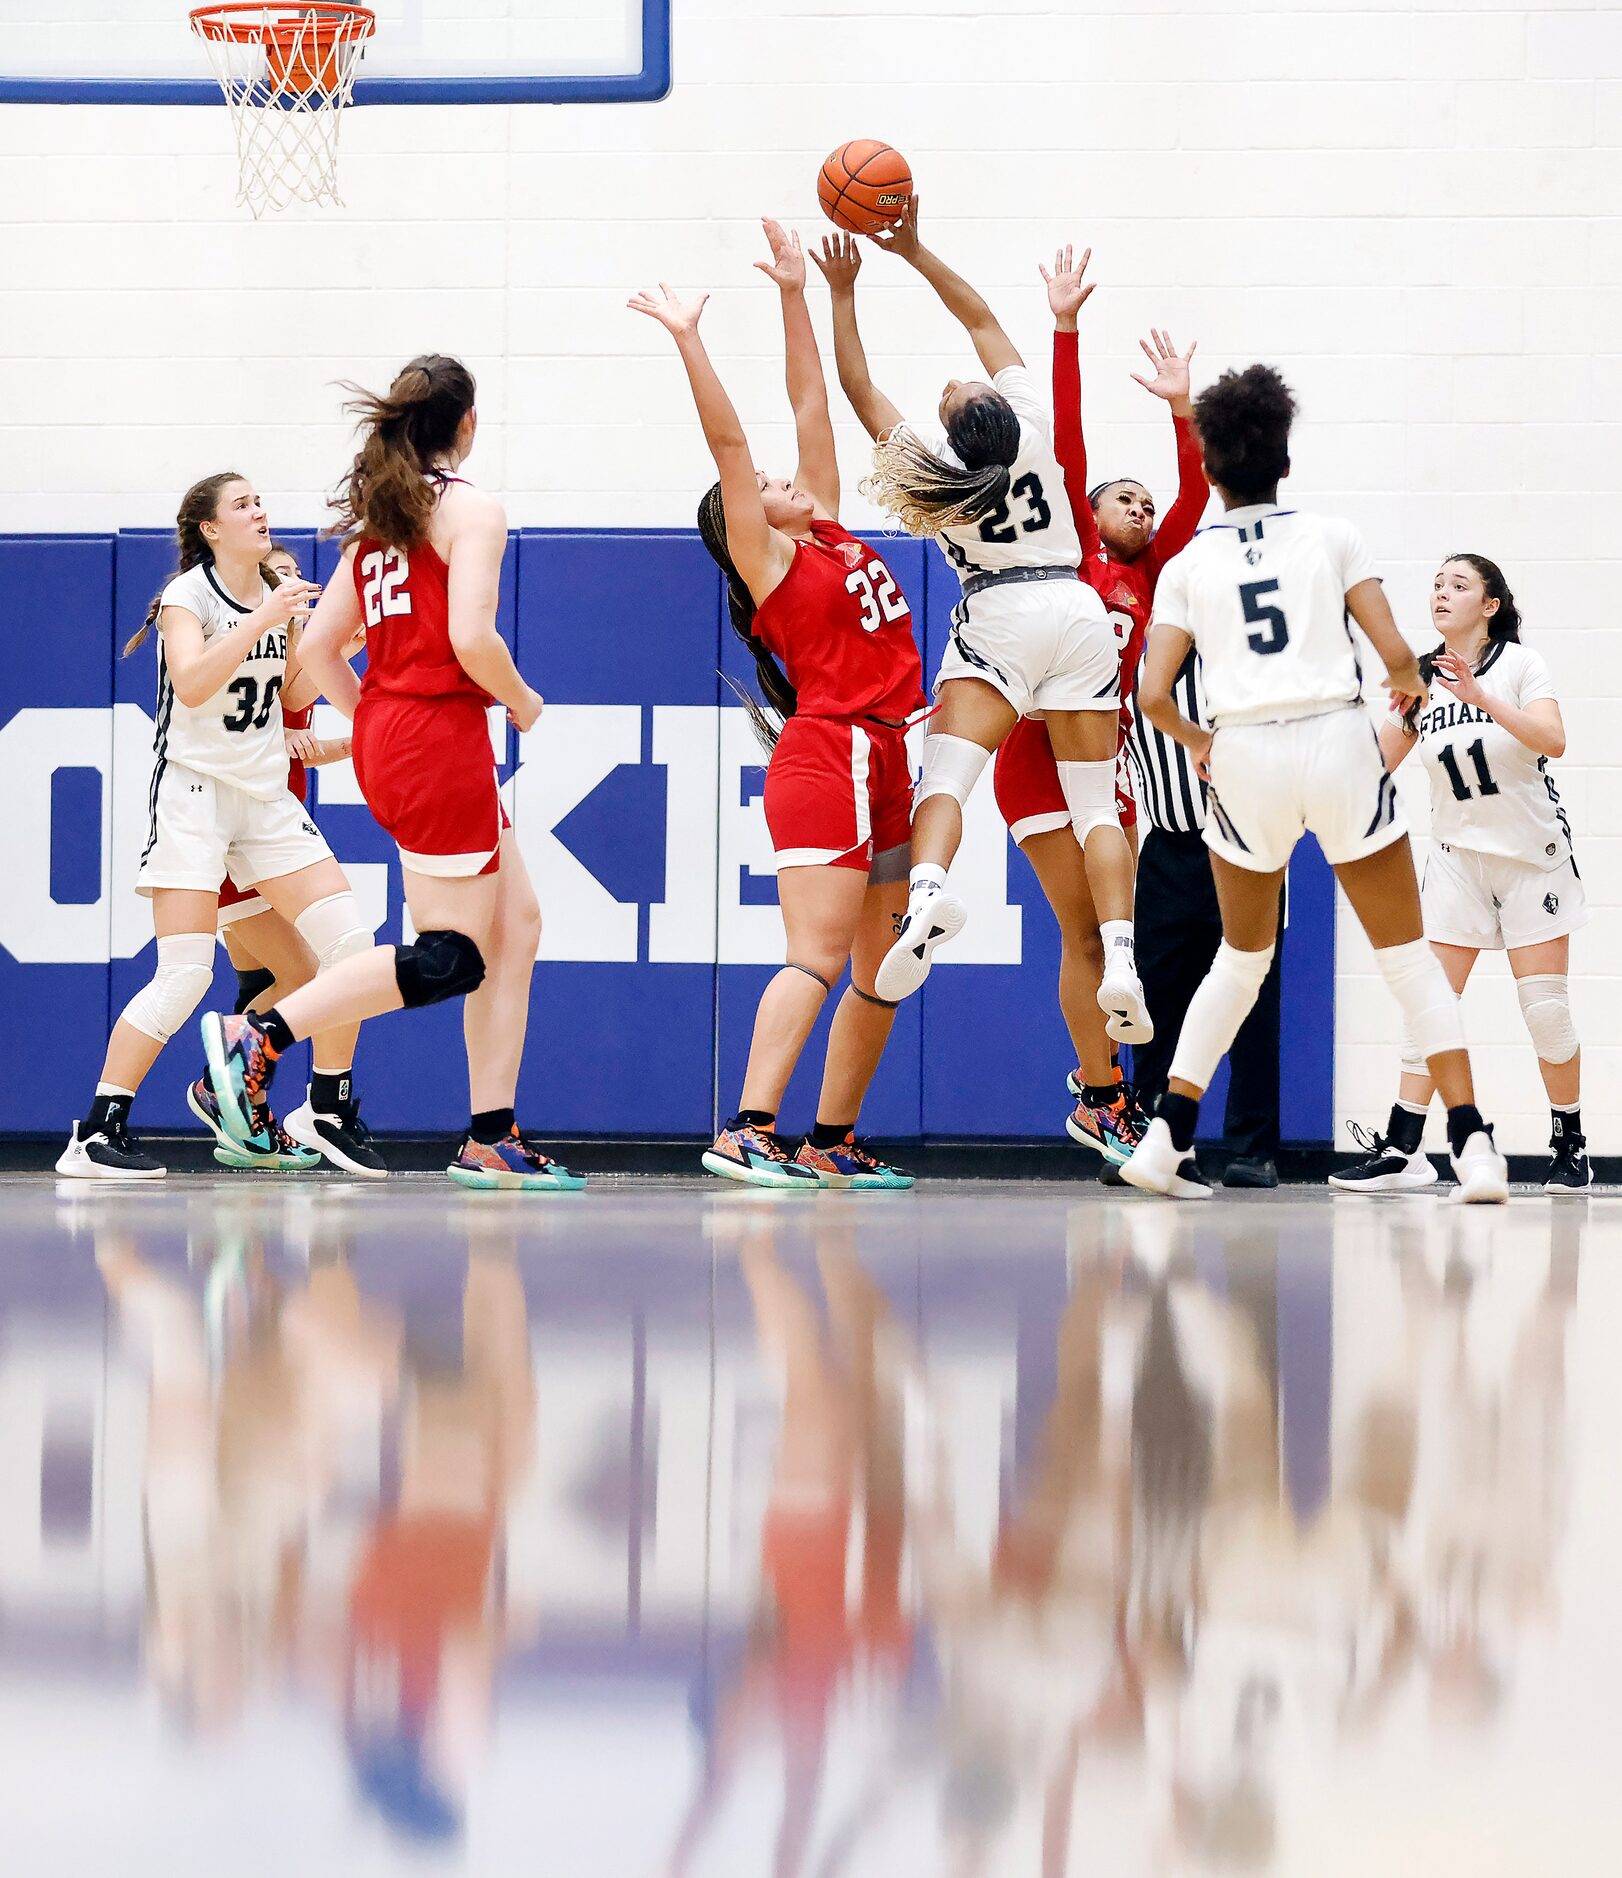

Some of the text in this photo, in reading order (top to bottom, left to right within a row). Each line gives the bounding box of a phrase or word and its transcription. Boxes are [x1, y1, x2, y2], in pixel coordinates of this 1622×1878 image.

[879, 195, 898, 204] PRO
[979, 471, 1051, 543] 23
[361, 545, 412, 627] 22
[845, 558, 911, 633] 32
[1240, 578, 1290, 655] 5
[223, 675, 283, 732] 30
[1438, 737, 1500, 801] 11
